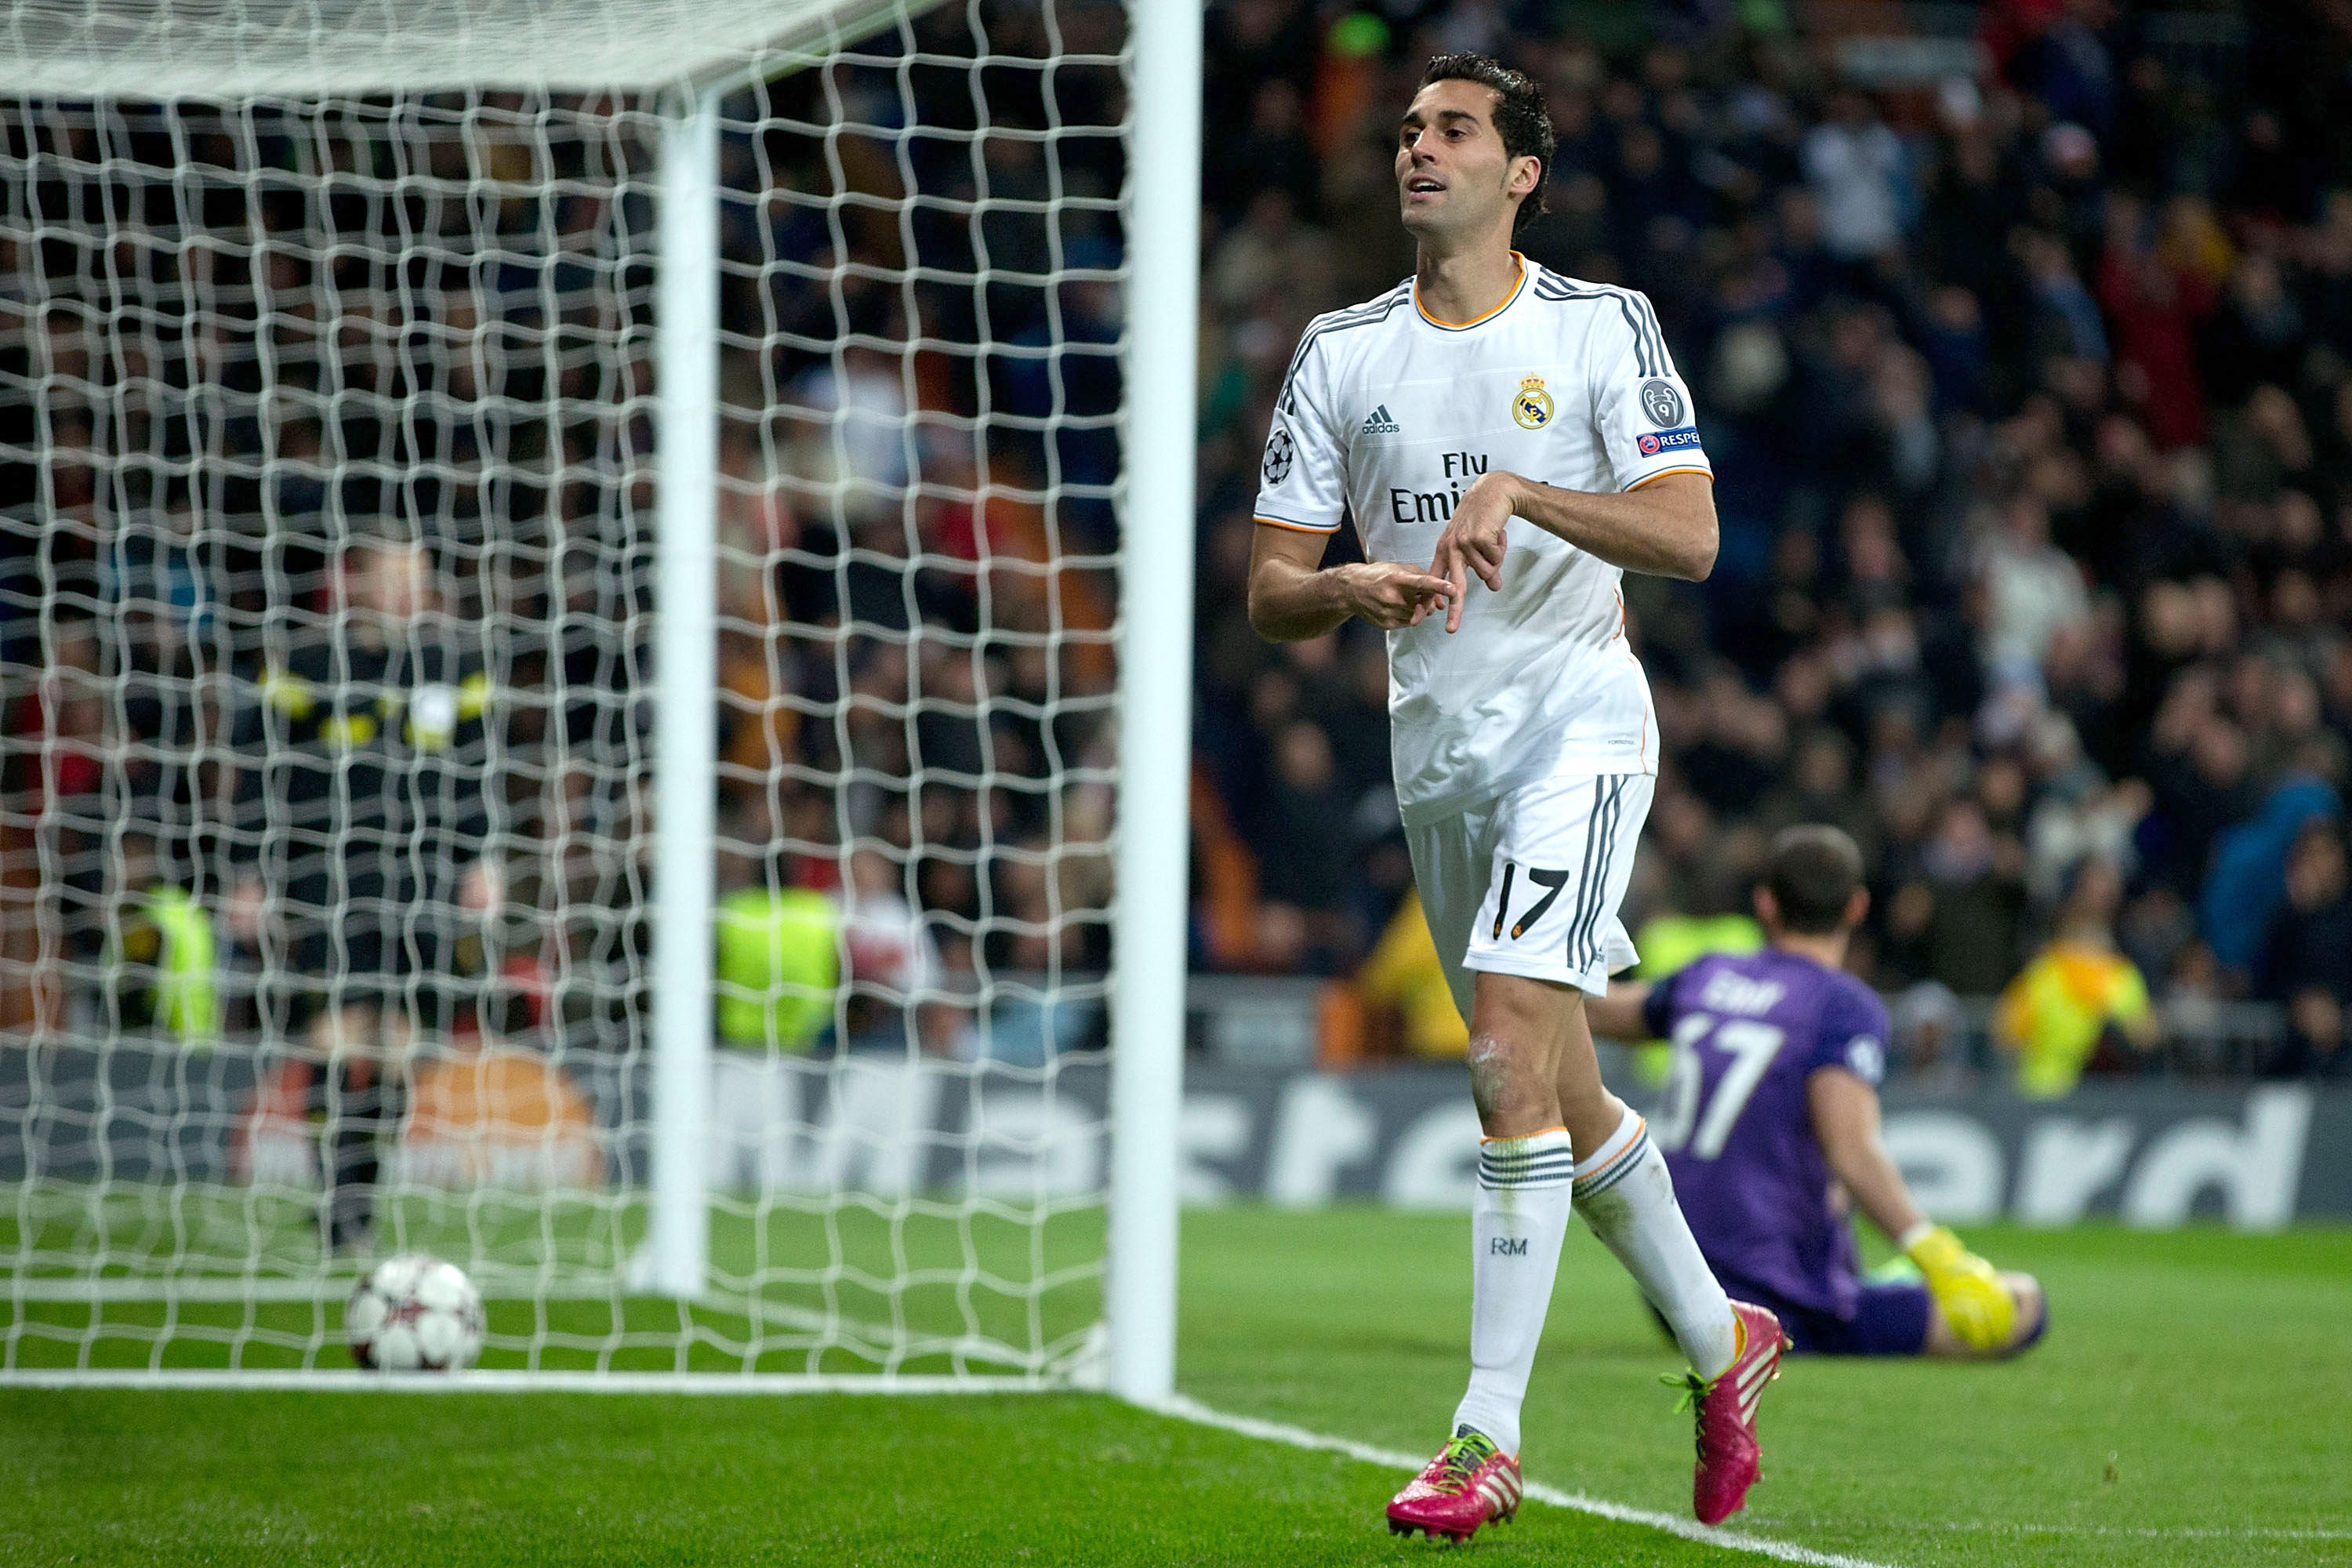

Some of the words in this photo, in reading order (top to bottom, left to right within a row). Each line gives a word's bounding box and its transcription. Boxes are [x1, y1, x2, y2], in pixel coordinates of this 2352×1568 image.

[1658, 403, 1670, 417] 9
[1362, 423, 1400, 434] adidas
[1660, 432, 1700, 447] RESPE
[1442, 452, 1488, 478] Fly
[1493, 862, 1570, 941] 17
[1491, 1237, 1528, 1256] RM
